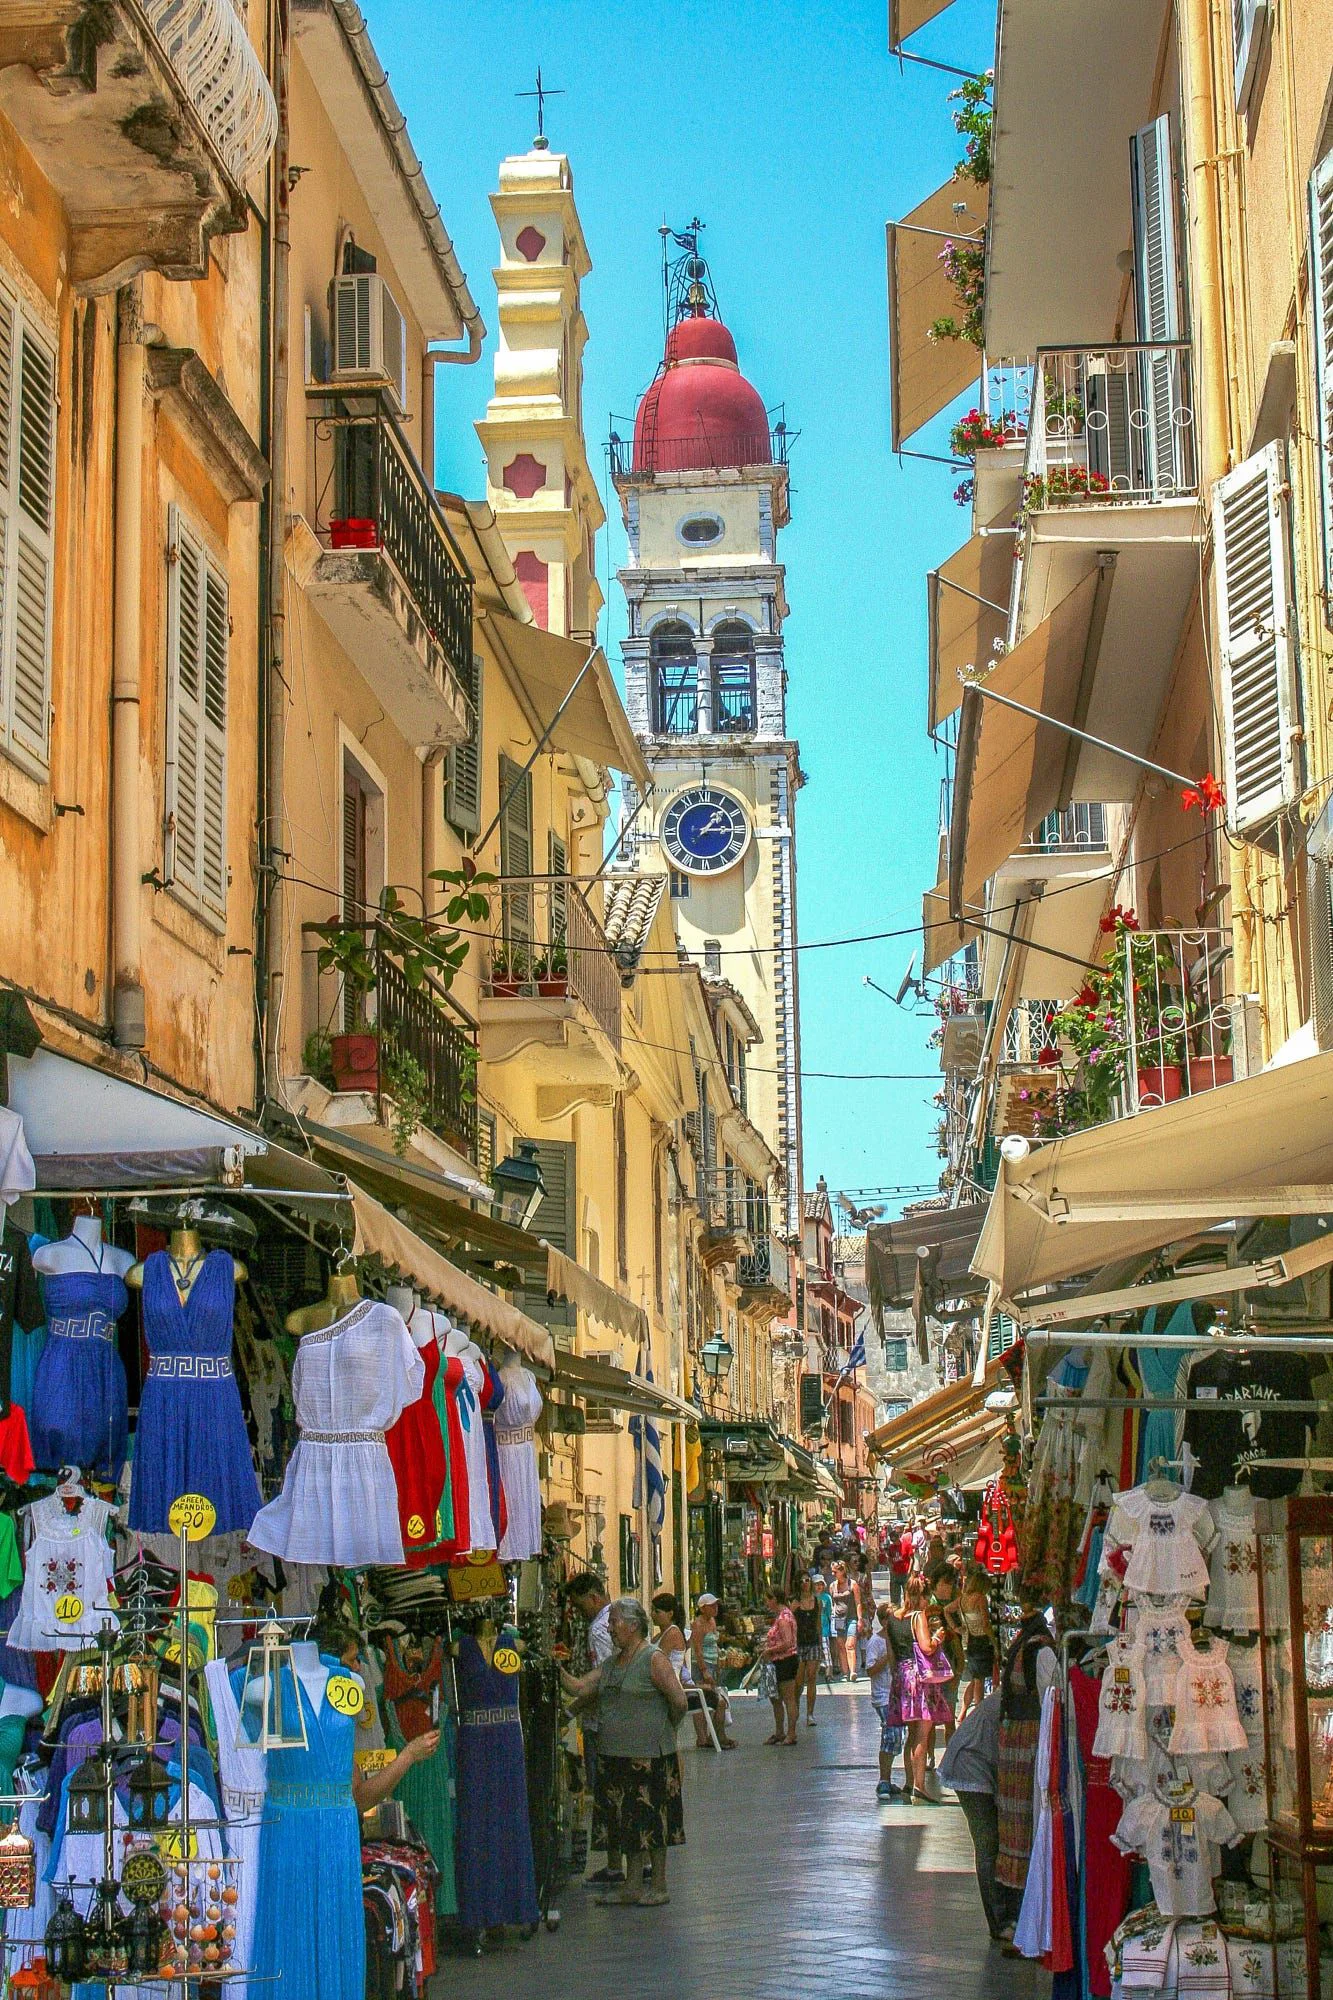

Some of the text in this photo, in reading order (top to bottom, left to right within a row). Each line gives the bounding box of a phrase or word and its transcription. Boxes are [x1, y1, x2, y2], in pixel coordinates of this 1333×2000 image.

[681, 795, 693, 809] XI
[698, 791, 711, 803] XII
[719, 796, 726, 806] I
[669, 809, 680, 820] X
[729, 808, 741, 818] II
[665, 826, 676, 836] IX
[701, 859, 711, 870] VI
[720, 854, 729, 866] V
[180, 1496, 204, 1505] GREEK
[171, 1503, 214, 1511] MEANDROS
